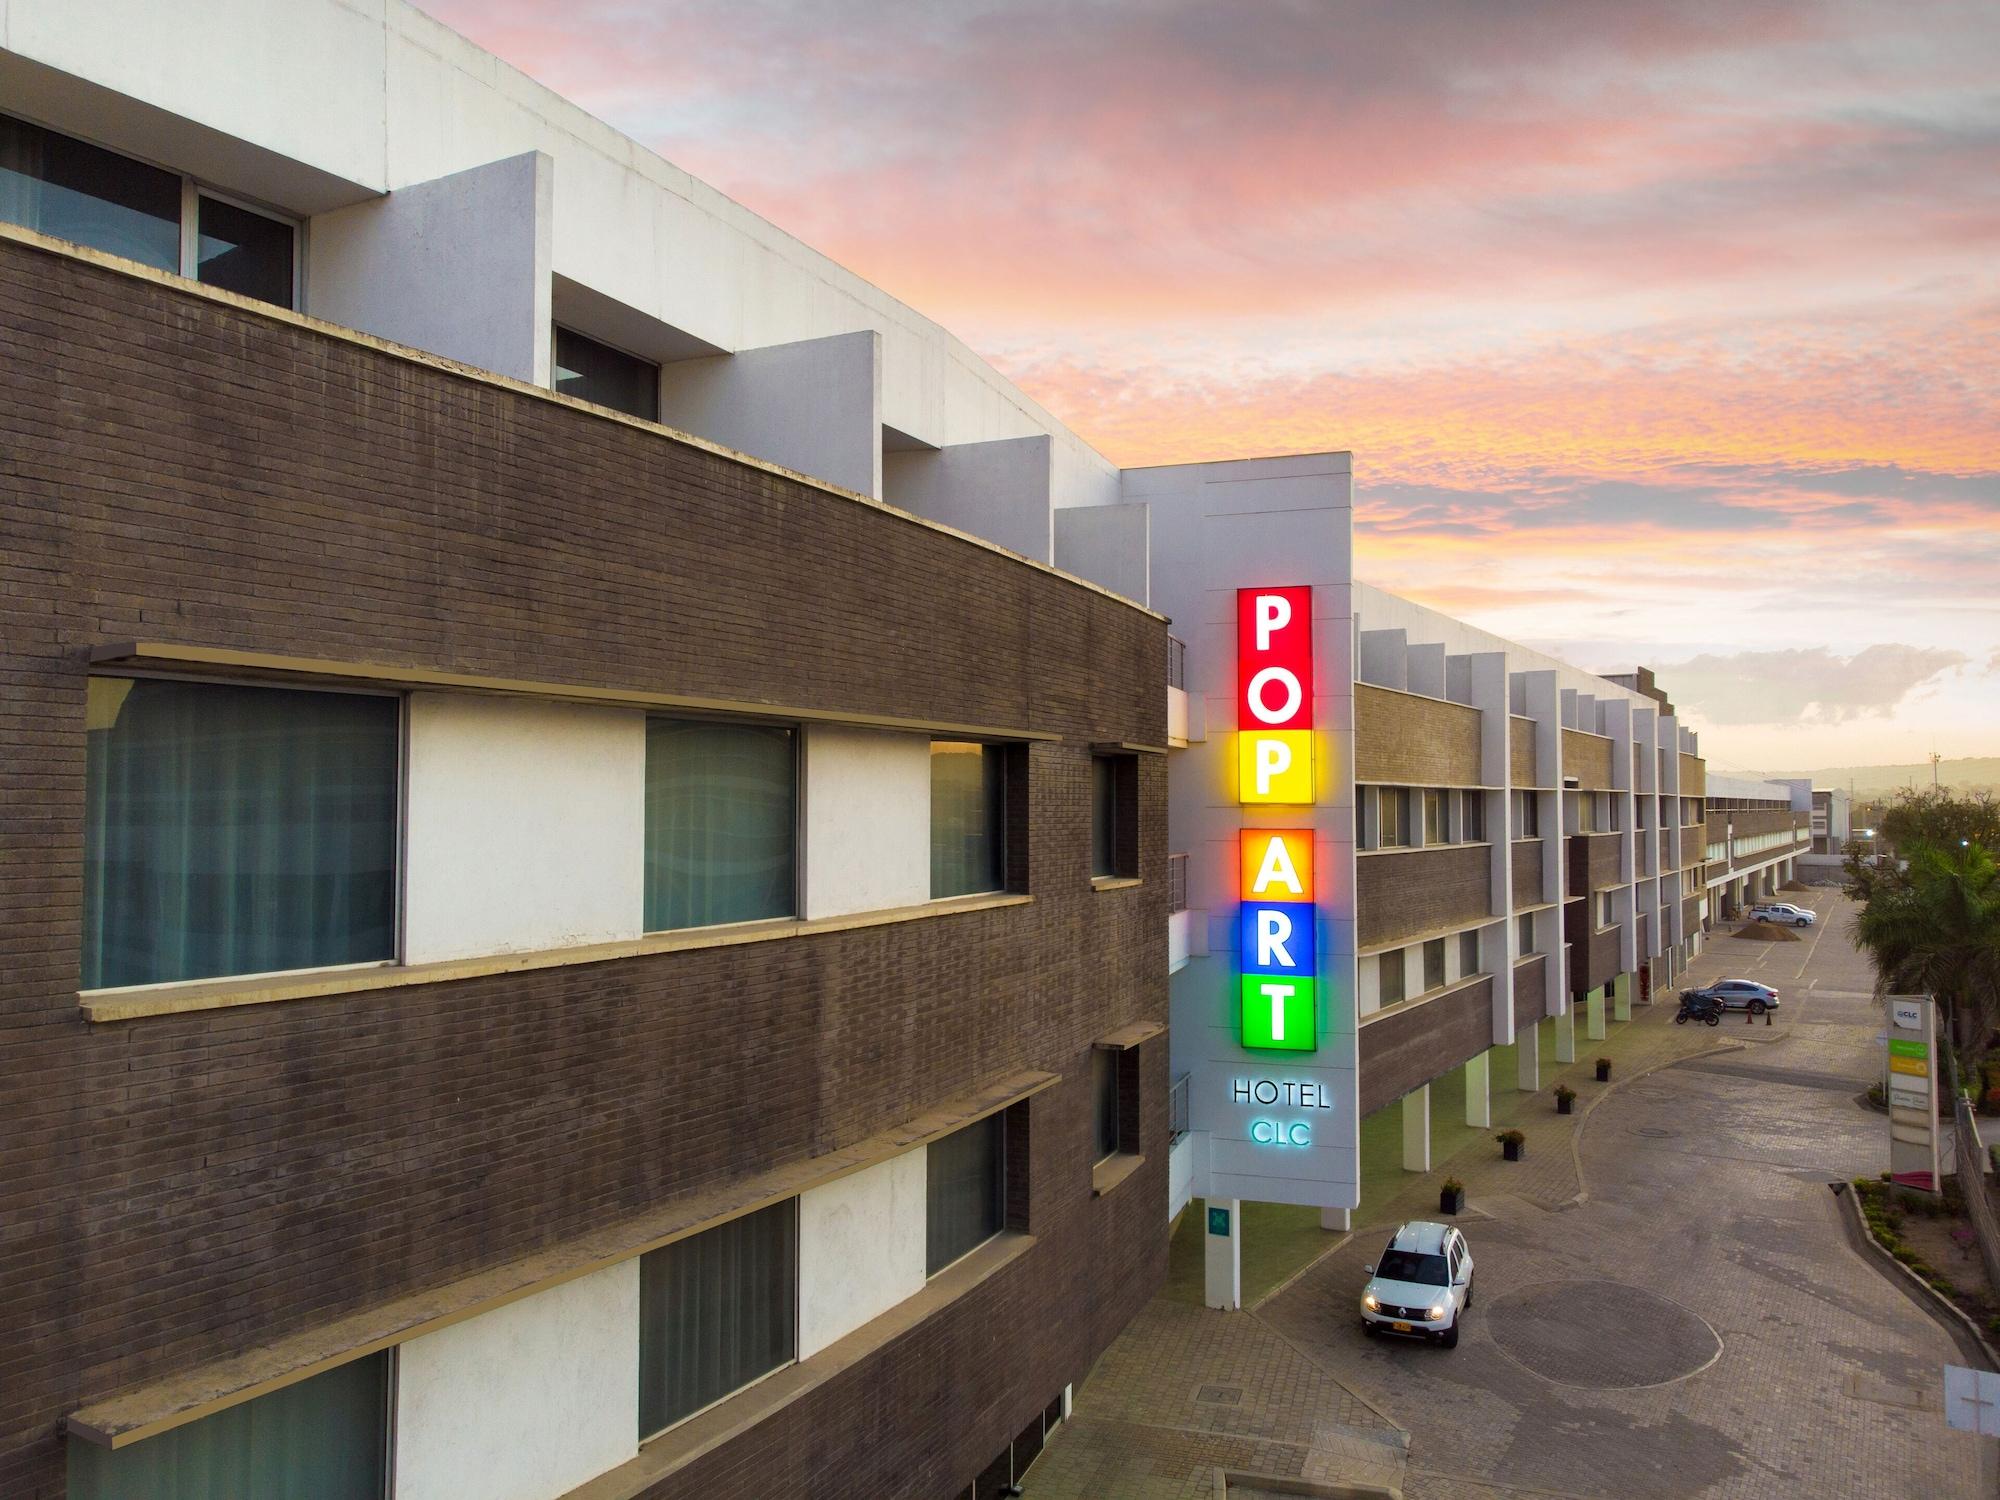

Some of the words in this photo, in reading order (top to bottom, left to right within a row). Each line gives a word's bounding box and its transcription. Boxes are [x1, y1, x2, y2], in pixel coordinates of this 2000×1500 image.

[1247, 595, 1302, 795] POP
[1252, 836, 1304, 1041] ART
[1903, 1011, 1918, 1019] CLC
[1233, 1079, 1331, 1109] HOTEL
[1251, 1121, 1310, 1146] CLC
